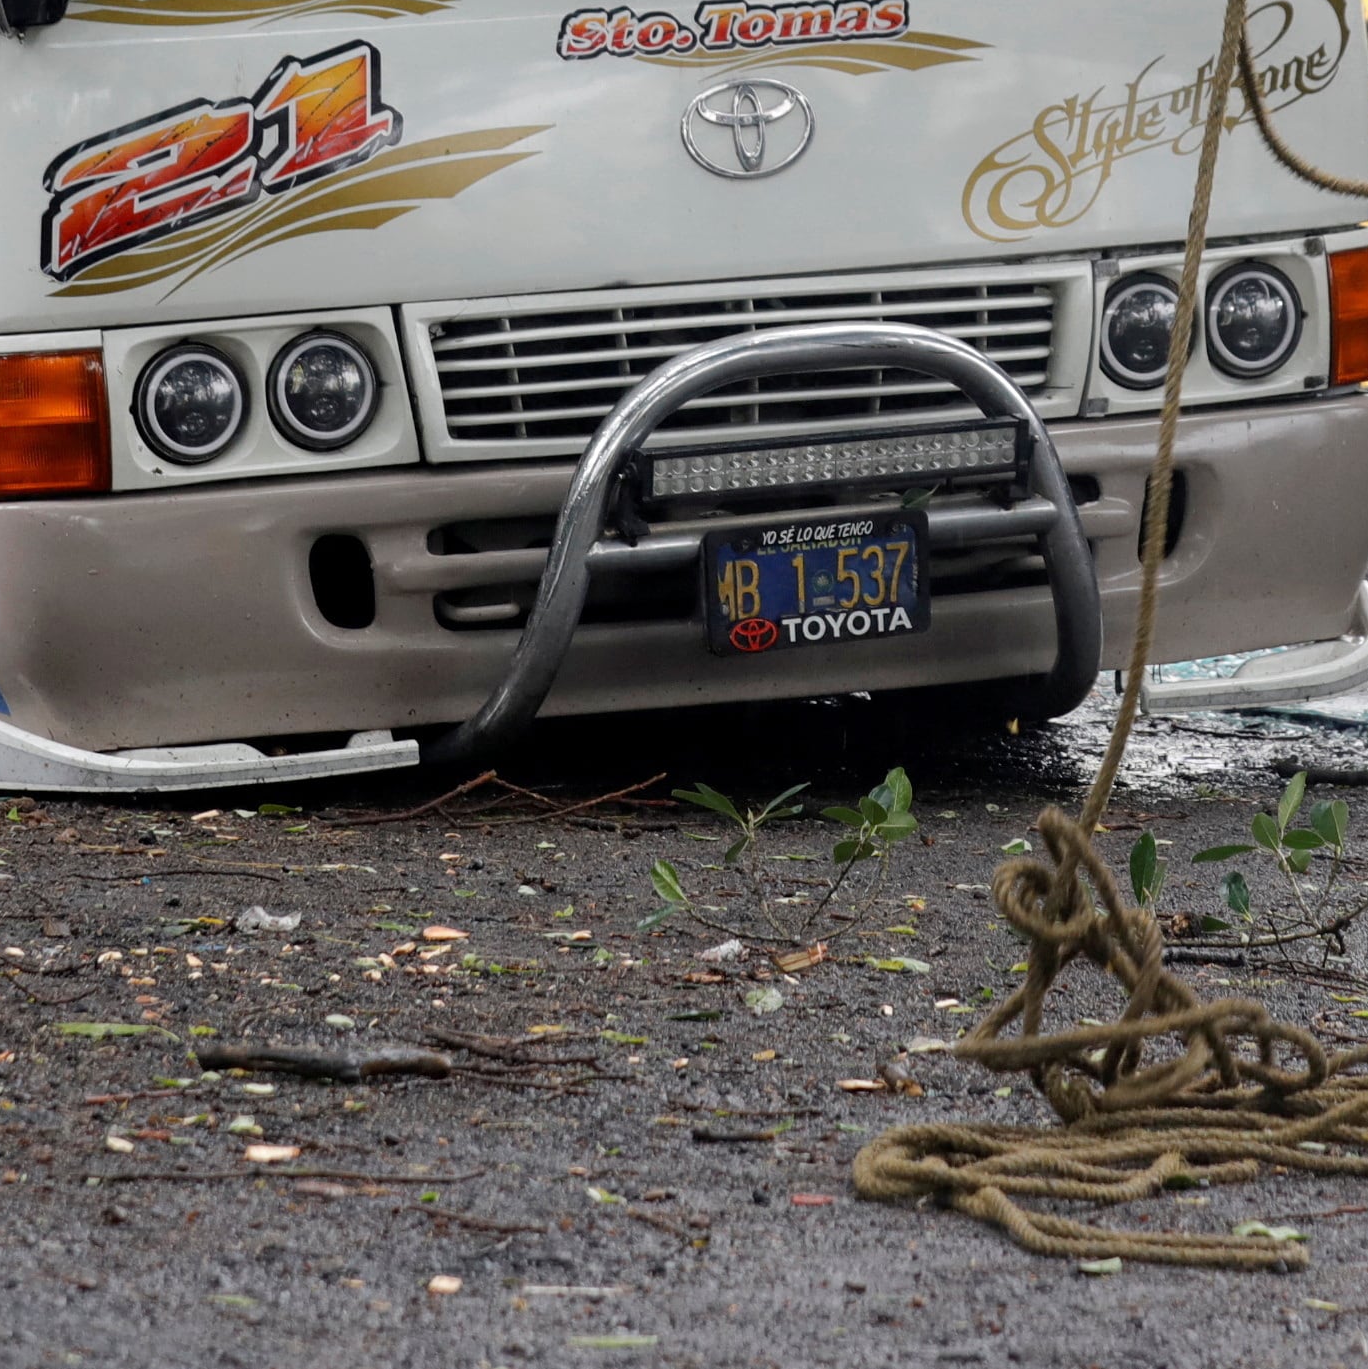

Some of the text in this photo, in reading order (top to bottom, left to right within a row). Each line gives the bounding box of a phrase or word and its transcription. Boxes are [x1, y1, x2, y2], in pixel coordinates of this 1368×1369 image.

[557, 6, 697, 60] Sto.
[41, 40, 404, 283] 21
[762, 531, 777, 546] YO
[796, 527, 813, 542] LO
[814, 524, 836, 540] QUE
[837, 521, 873, 537] TENGO
[837, 541, 909, 609] 537
[782, 606, 913, 643] TOYOTA
